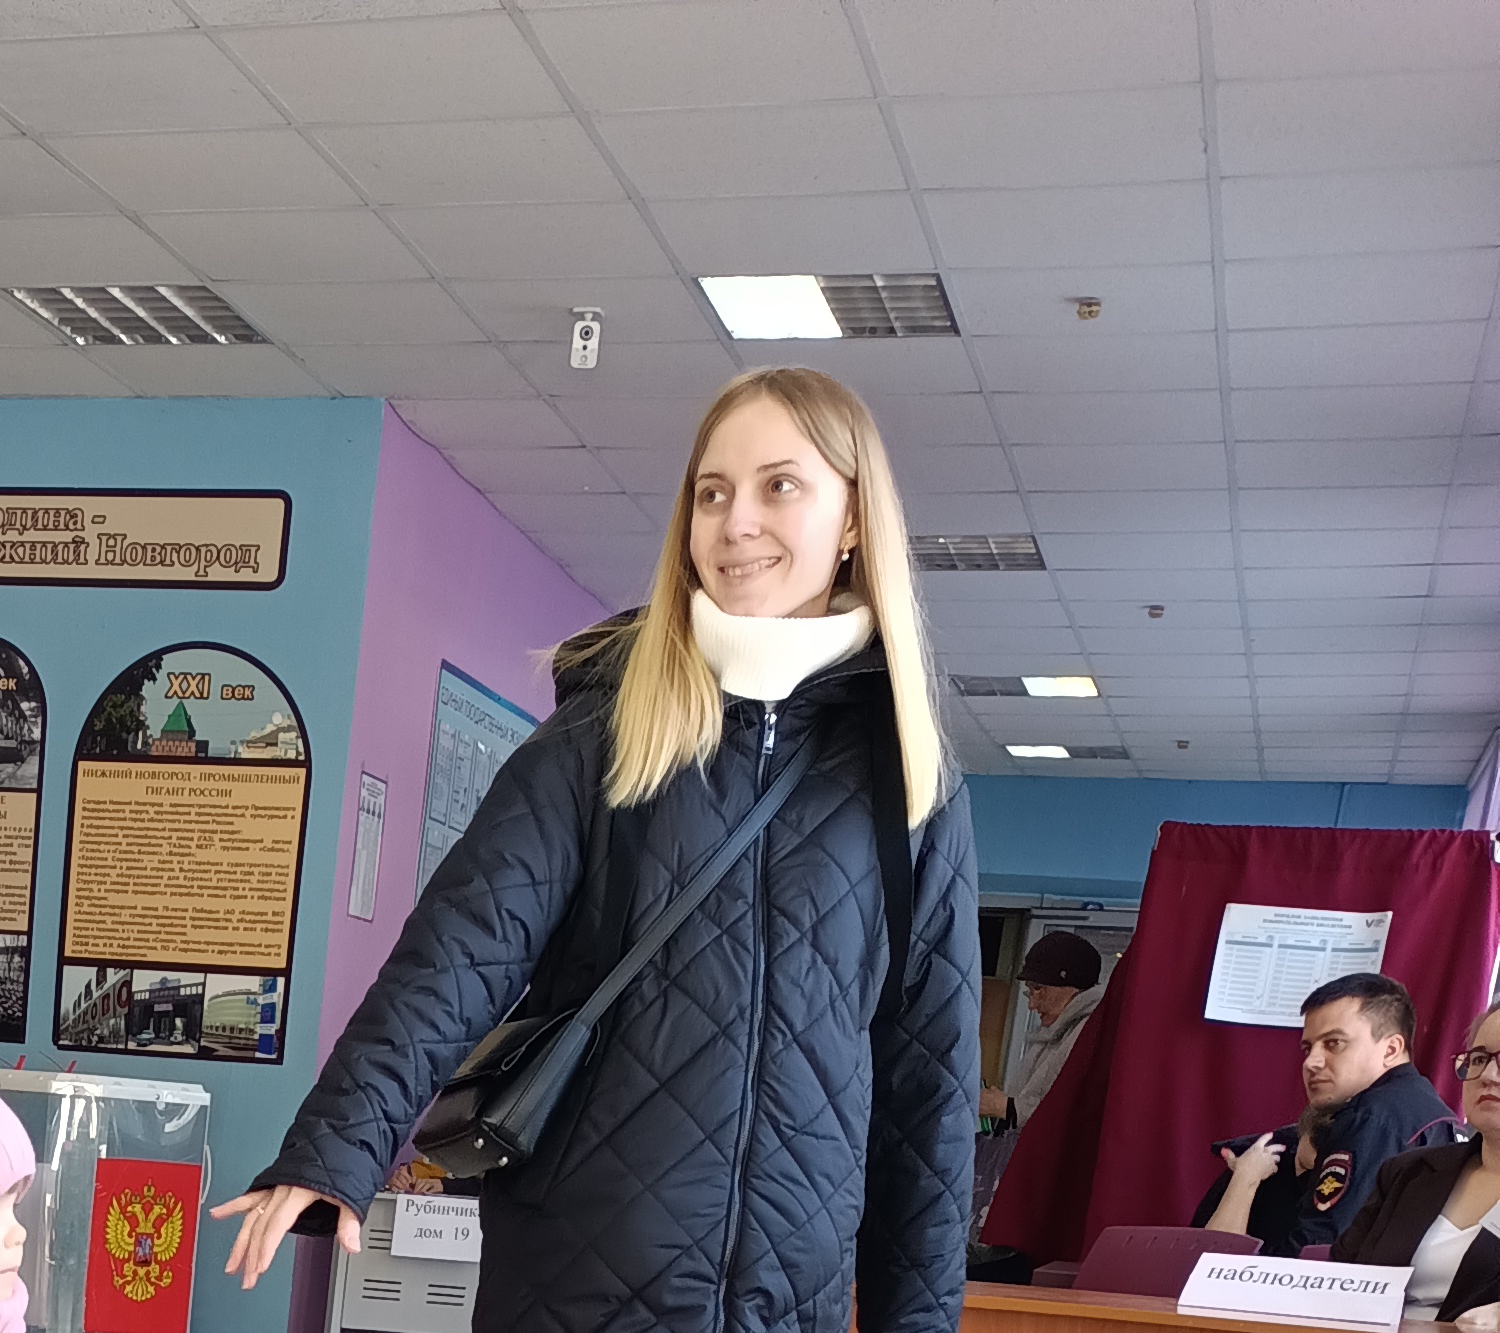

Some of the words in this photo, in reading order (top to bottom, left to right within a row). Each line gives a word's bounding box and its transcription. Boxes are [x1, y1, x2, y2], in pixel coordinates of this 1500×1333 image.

[94, 532, 261, 579] Новгород
[164, 671, 212, 700] XXI
[221, 684, 256, 701] век
[82, 766, 132, 780] НИЖНИЙ
[134, 769, 191, 783] НОВГОРОД
[199, 772, 300, 786] ПРОМЫШЛЕННЫЙ
[145, 785, 187, 798] ГИГАНТ
[188, 787, 233, 799] РОССИИ
[405, 1199, 480, 1218] Рубинчик
[414, 1227, 443, 1240] дом
[454, 1226, 471, 1242] 19
[1206, 1265, 1392, 1296] наблюдатели
